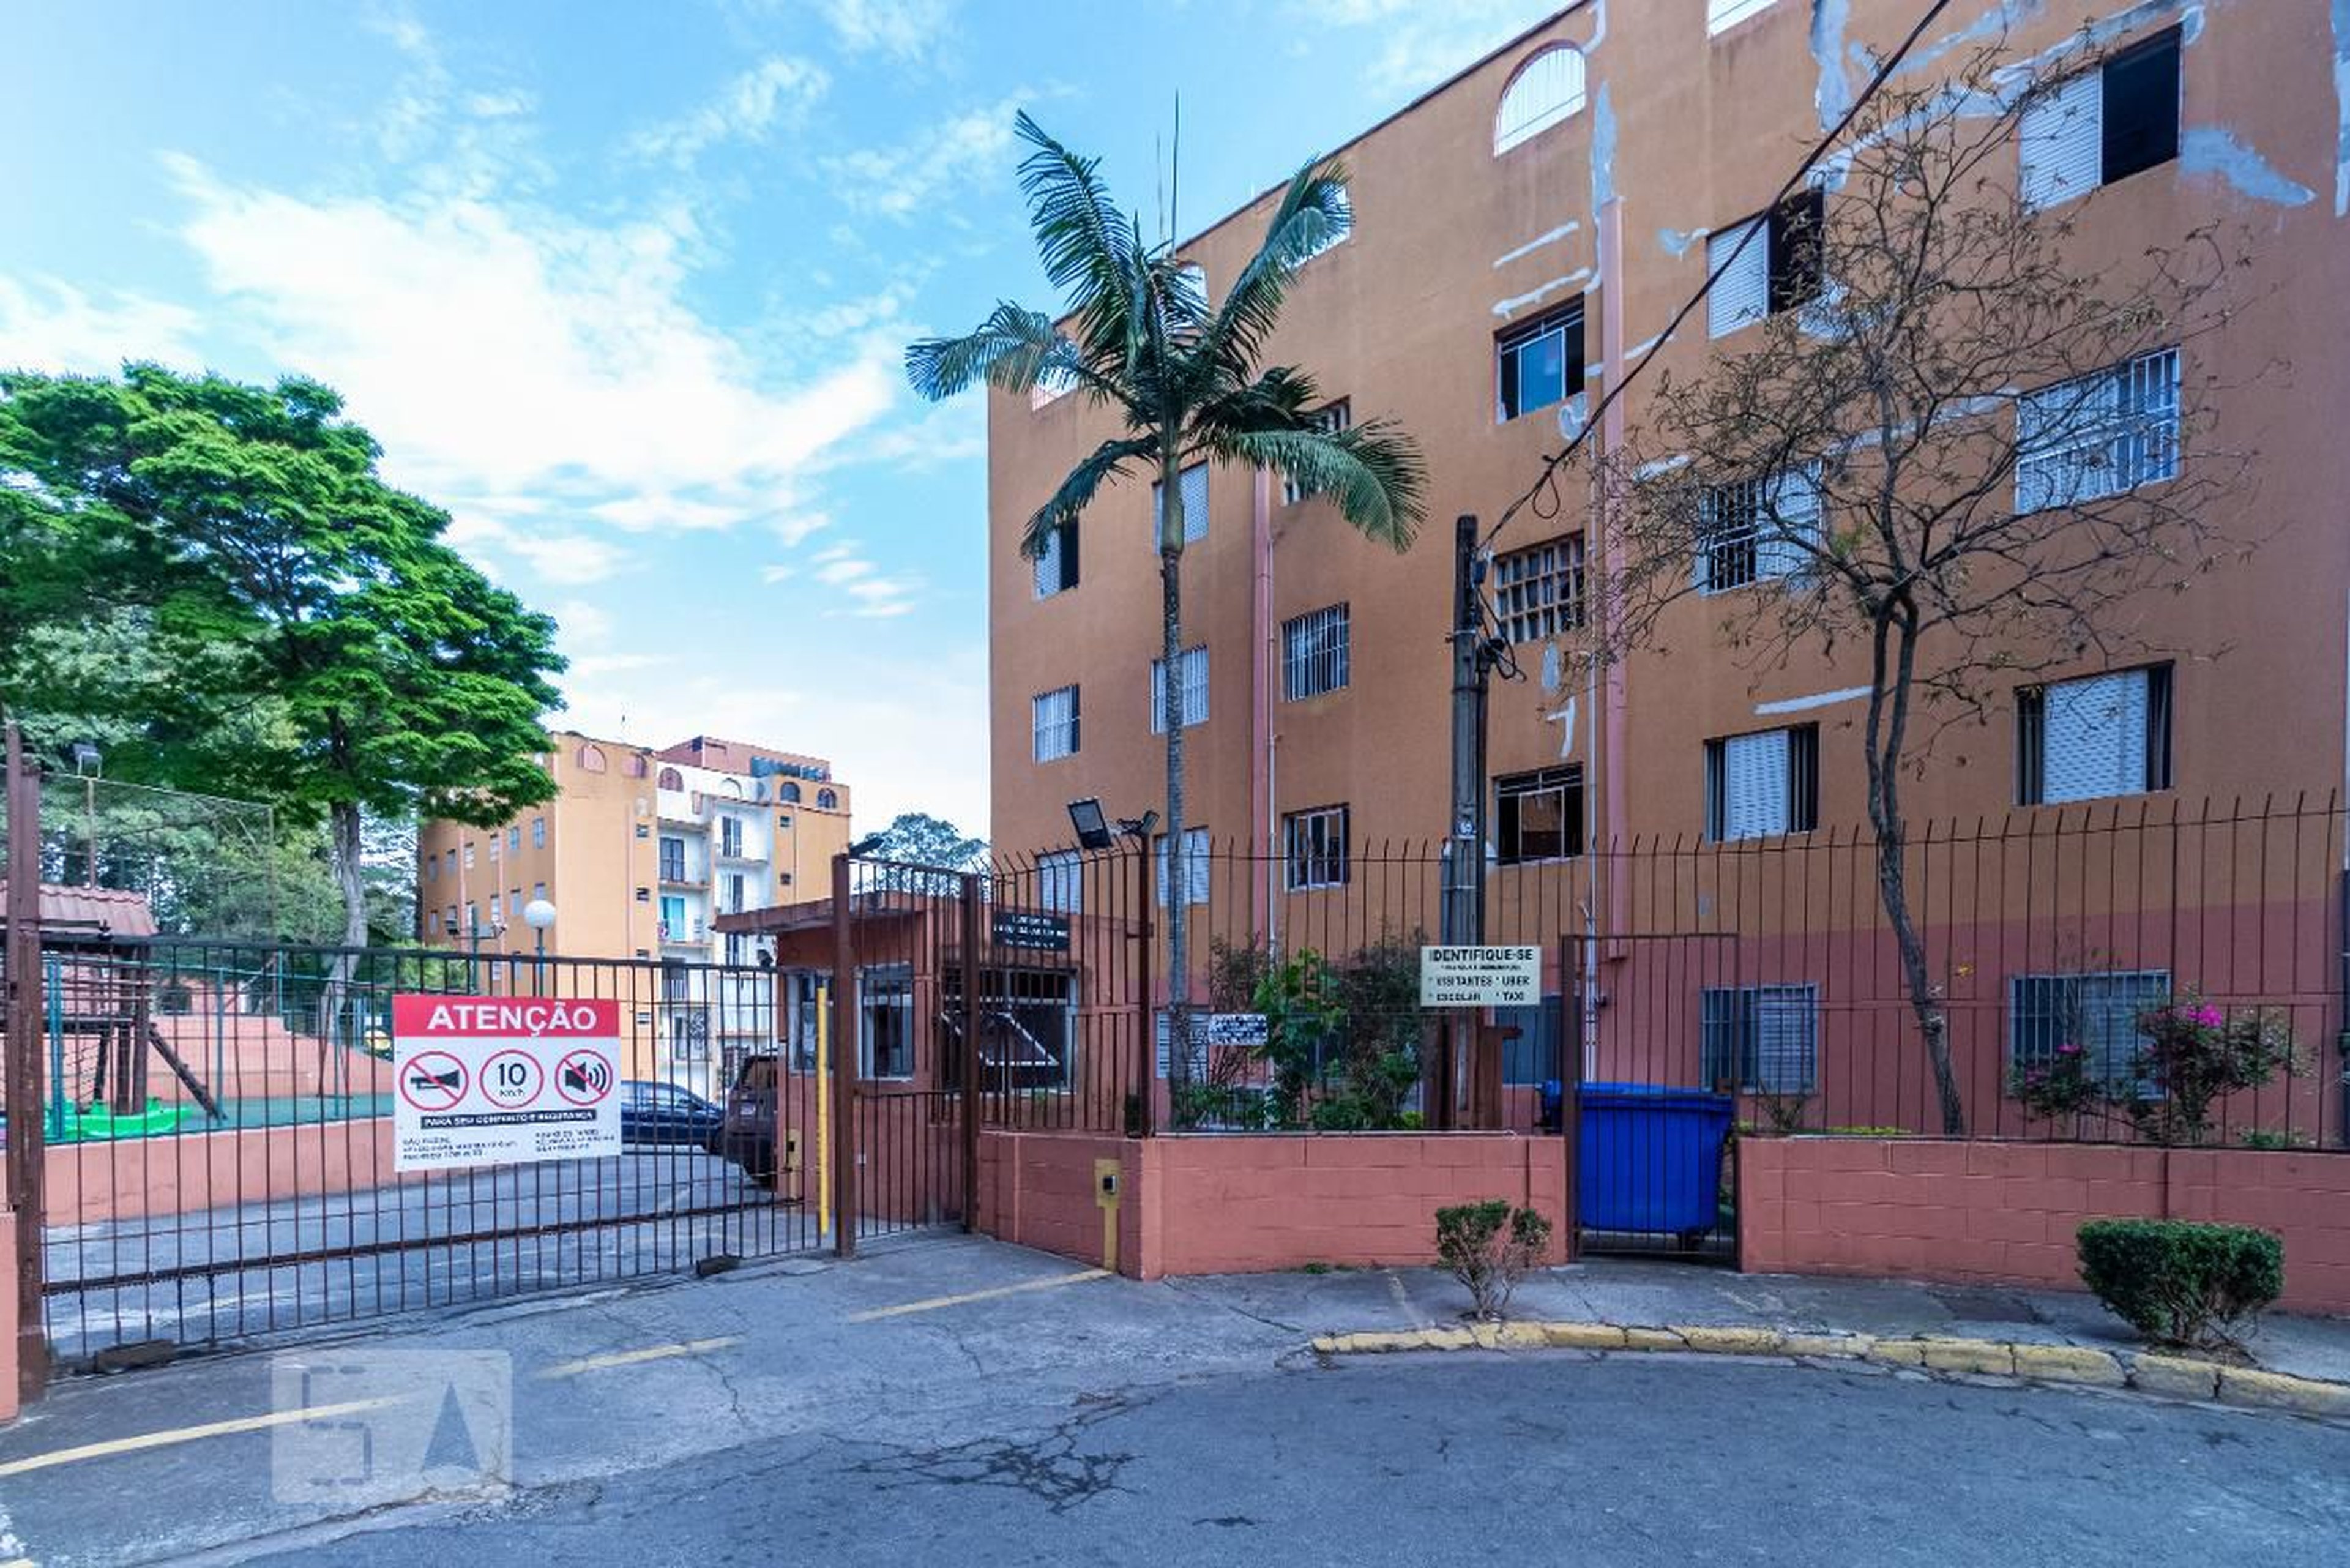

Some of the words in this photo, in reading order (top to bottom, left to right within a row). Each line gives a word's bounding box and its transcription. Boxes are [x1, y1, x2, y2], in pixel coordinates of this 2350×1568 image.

[1429, 949, 1533, 961] IDENTIFIQUE-SE
[1502, 976, 1530, 986] UBER
[1502, 991, 1524, 1001] TAXI
[427, 1001, 597, 1037] ATENÇÃO
[498, 1062, 526, 1087] 10
